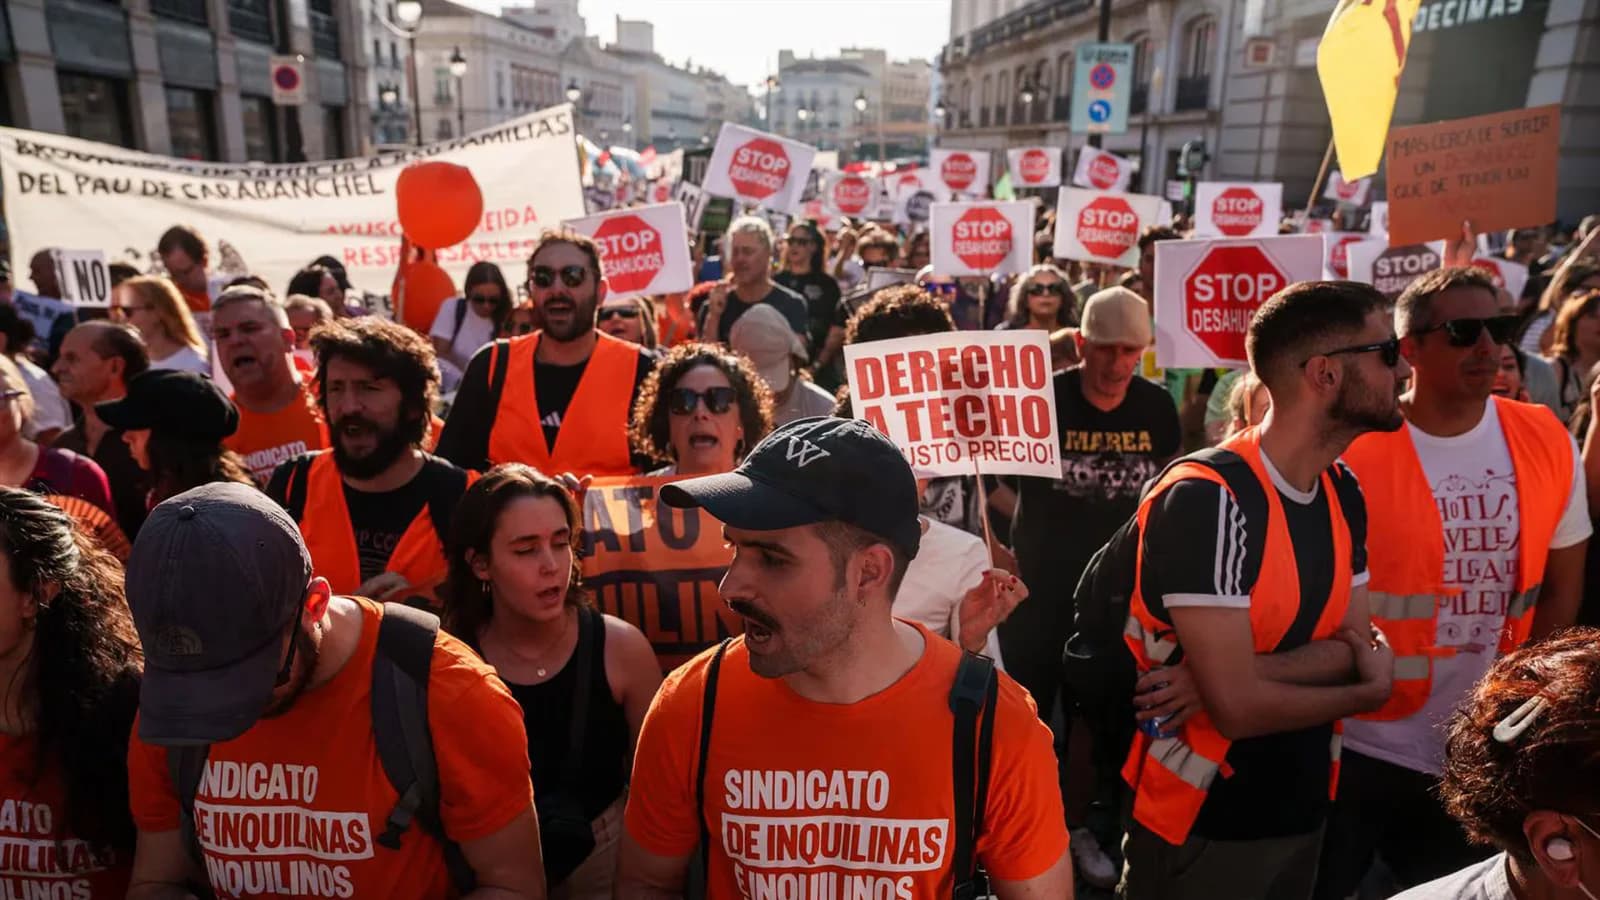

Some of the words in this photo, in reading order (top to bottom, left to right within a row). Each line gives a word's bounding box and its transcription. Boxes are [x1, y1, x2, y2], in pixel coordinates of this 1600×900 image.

[735, 147, 789, 171] STOP
[17, 172, 67, 195] DEL
[74, 173, 131, 195] PAU
[142, 180, 174, 200] DE
[181, 173, 385, 201] CARABANCHEL
[1430, 177, 1449, 195] DE
[1082, 208, 1135, 229] STOP
[1216, 198, 1260, 212] STOP
[595, 229, 655, 255] STOP
[955, 220, 1009, 239] STOP
[602, 253, 664, 277] ESAHUCIOS
[1376, 252, 1437, 276] STOP
[73, 259, 107, 302] NO
[1193, 272, 1278, 302] STOP
[854, 344, 1047, 401] DERECHO
[864, 405, 891, 438] A
[896, 394, 1051, 443] TECHO
[786, 436, 831, 468] W
[968, 440, 1055, 466] PRECIO!
[1065, 430, 1153, 452] MAREA
[582, 486, 701, 557] ATO
[724, 768, 890, 812] SINDICATO
[0, 799, 52, 834] ATO
[213, 811, 367, 855] INQUILINAS
[726, 821, 761, 861] DE
[767, 821, 943, 865] INQUILINAS
